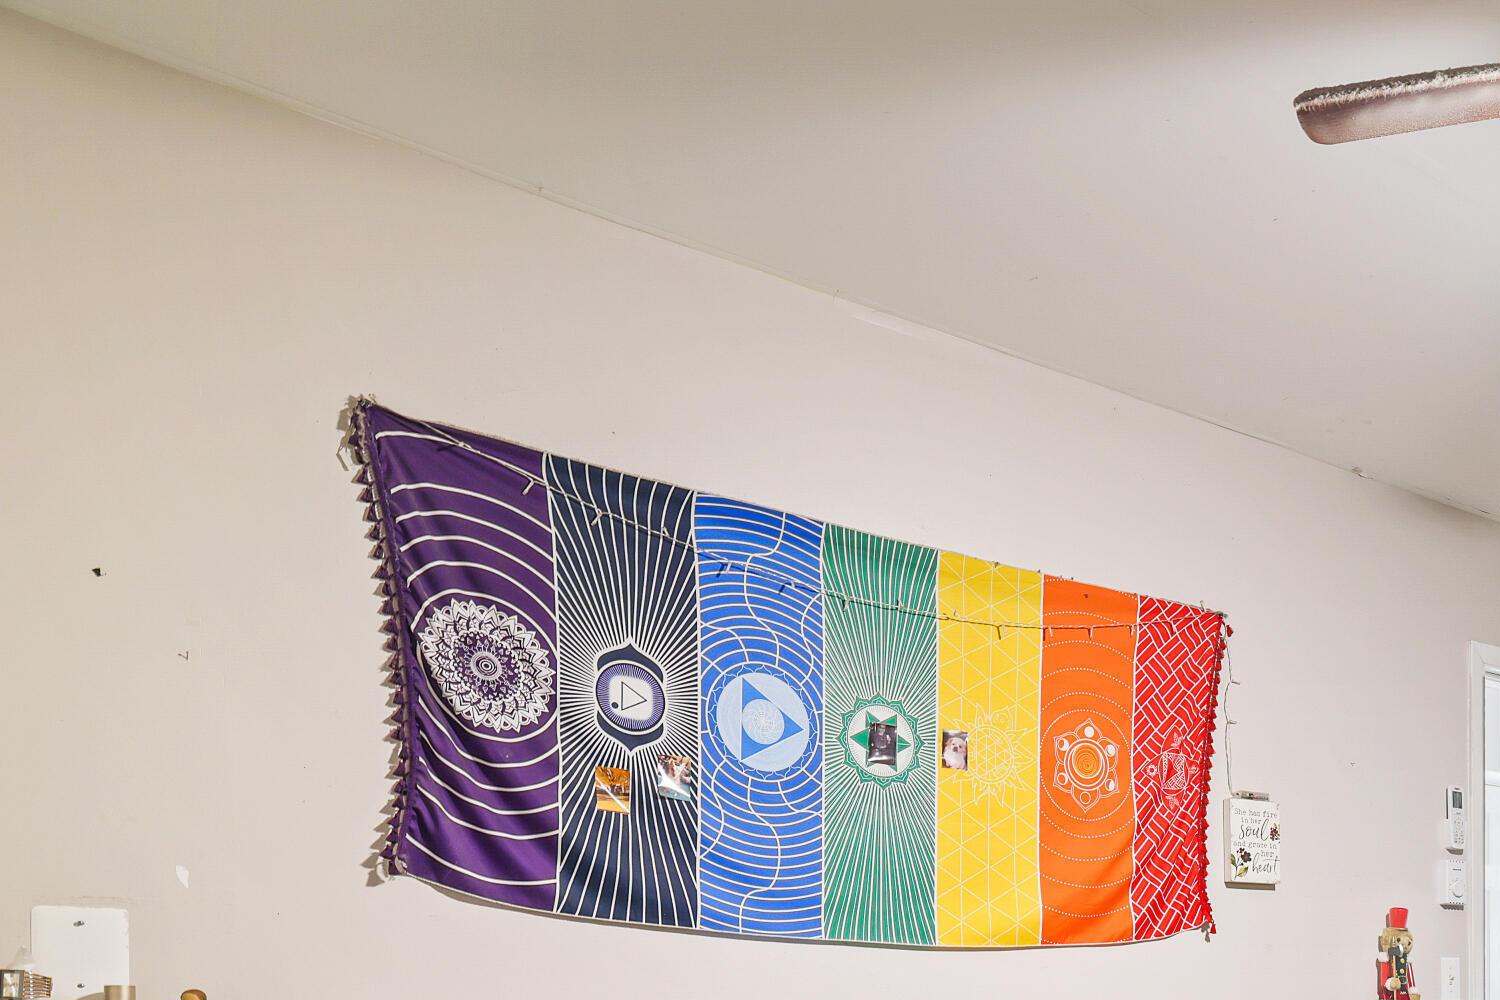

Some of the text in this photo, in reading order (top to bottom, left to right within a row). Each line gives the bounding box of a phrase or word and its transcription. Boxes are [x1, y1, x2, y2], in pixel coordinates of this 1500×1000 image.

[1263, 810, 1278, 818] fire
[1239, 818, 1270, 841] soul
[1252, 853, 1280, 874] heart
